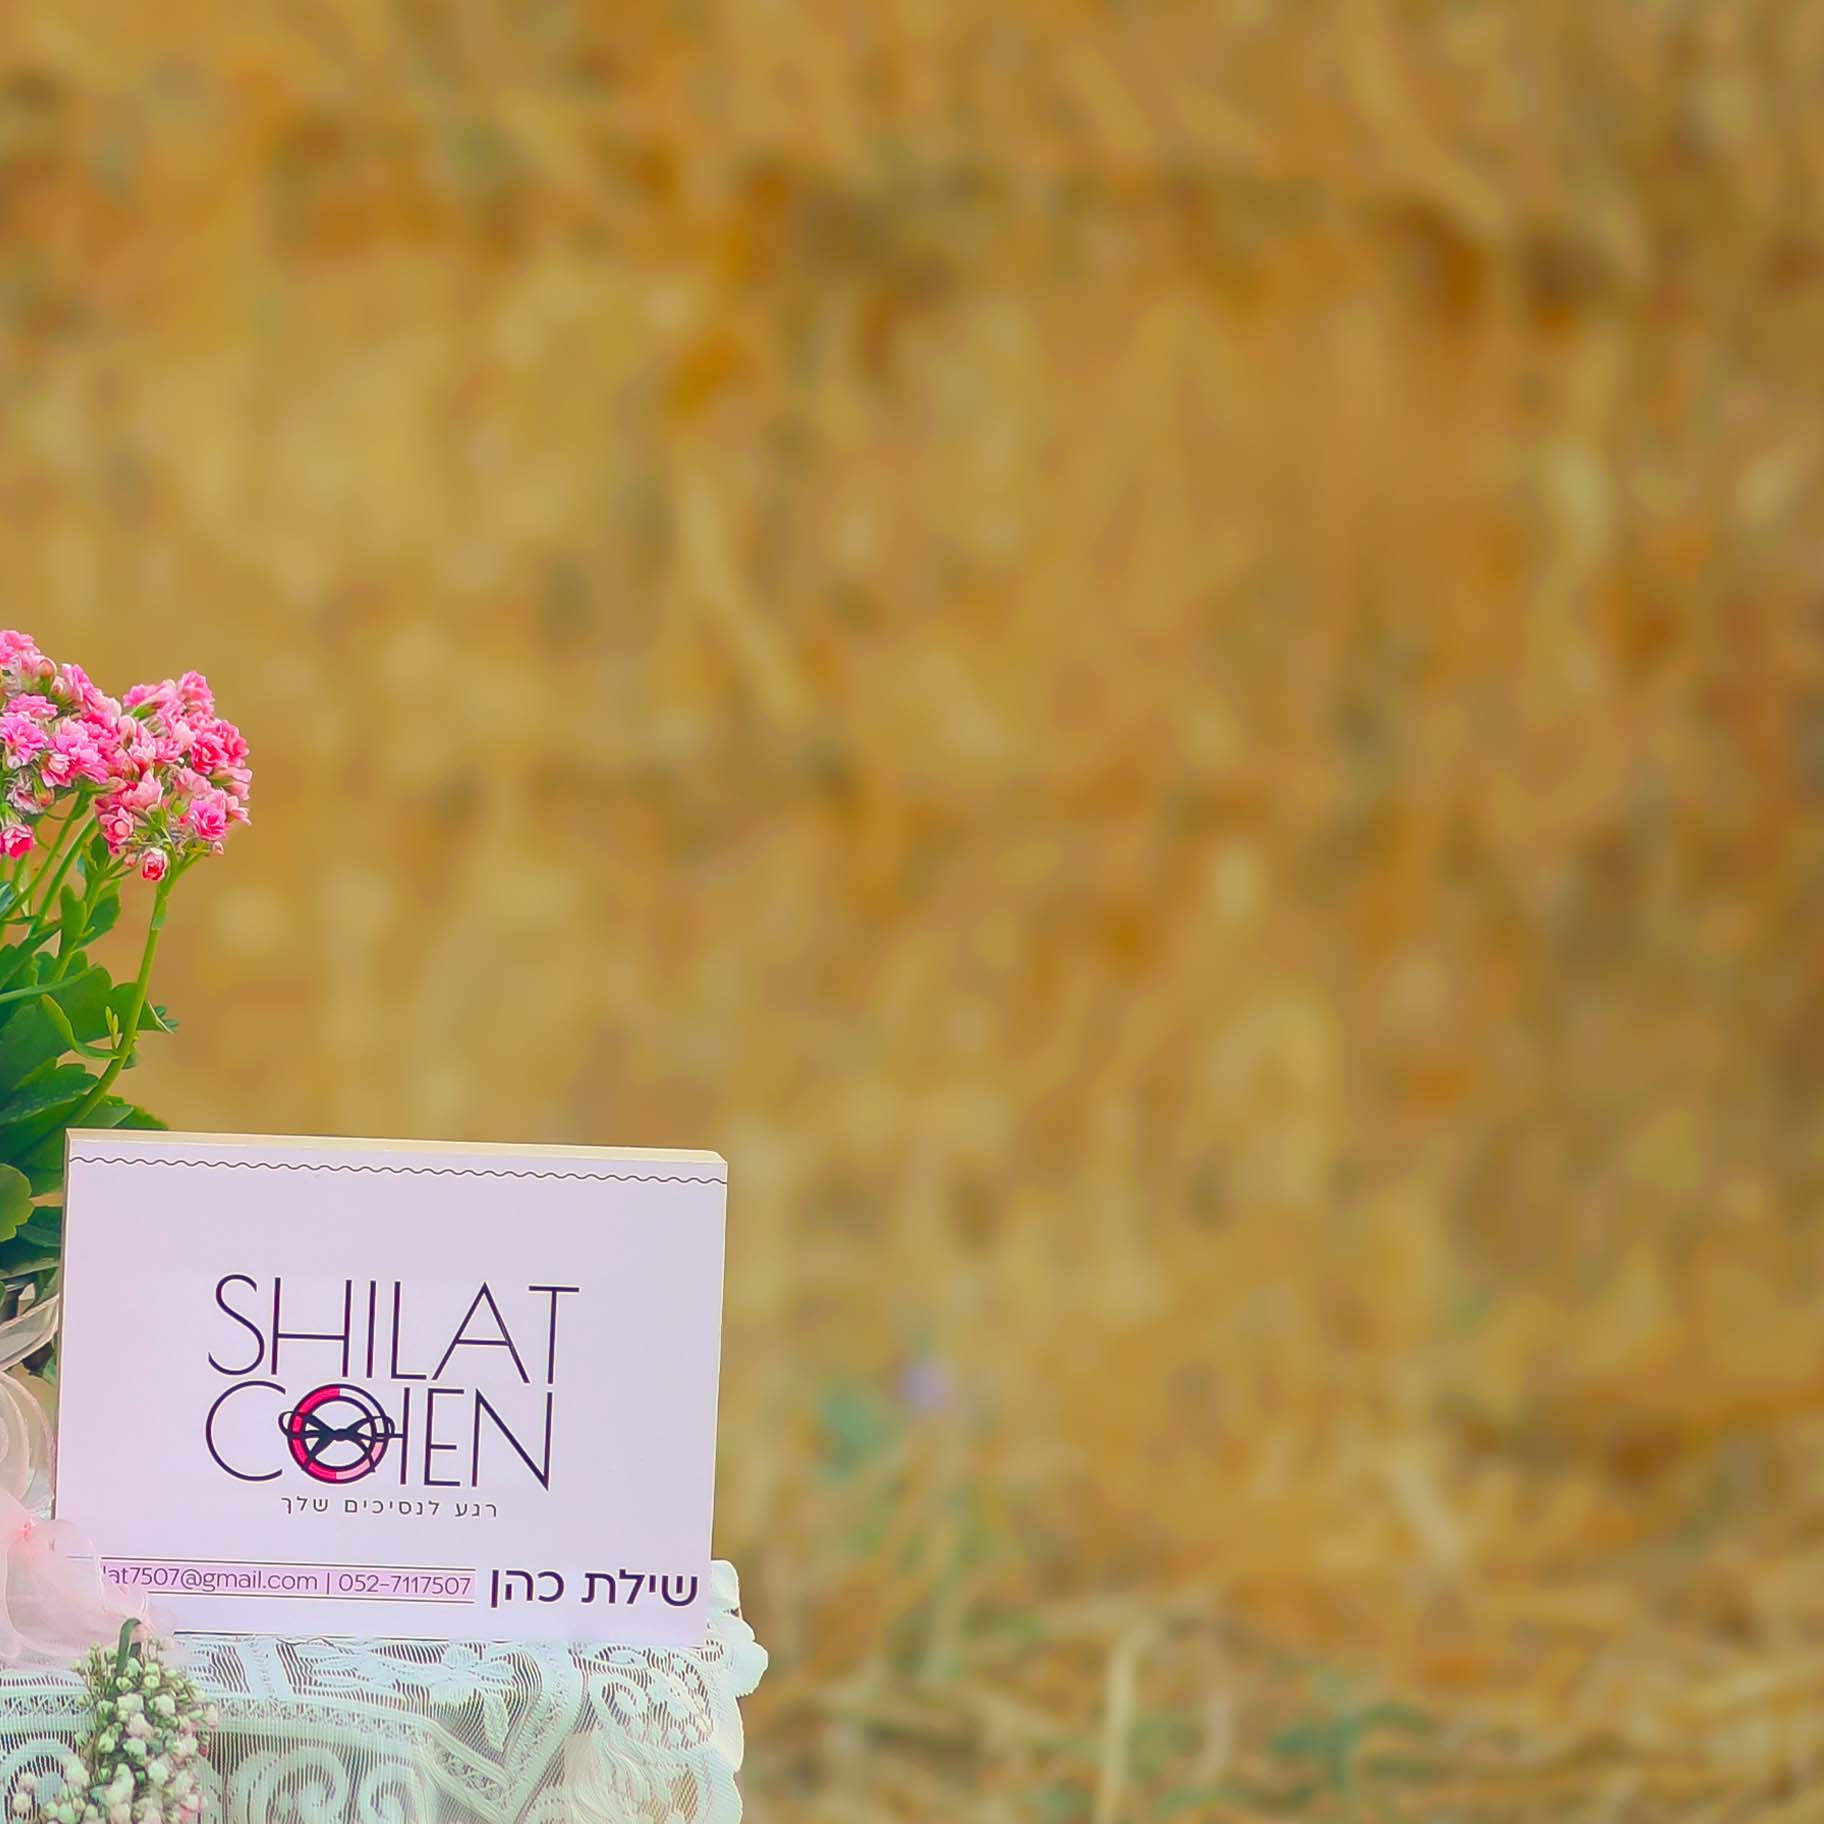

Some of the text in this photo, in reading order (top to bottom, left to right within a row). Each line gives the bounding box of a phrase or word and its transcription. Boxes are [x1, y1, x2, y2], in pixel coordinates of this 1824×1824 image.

[207, 1273, 581, 1385] SHILAT
[280, 1495, 498, 1518] רגע לנסיכים שלך
[338, 1572, 472, 1596] 052-7117507
[489, 1568, 699, 1609] שילת כהן
